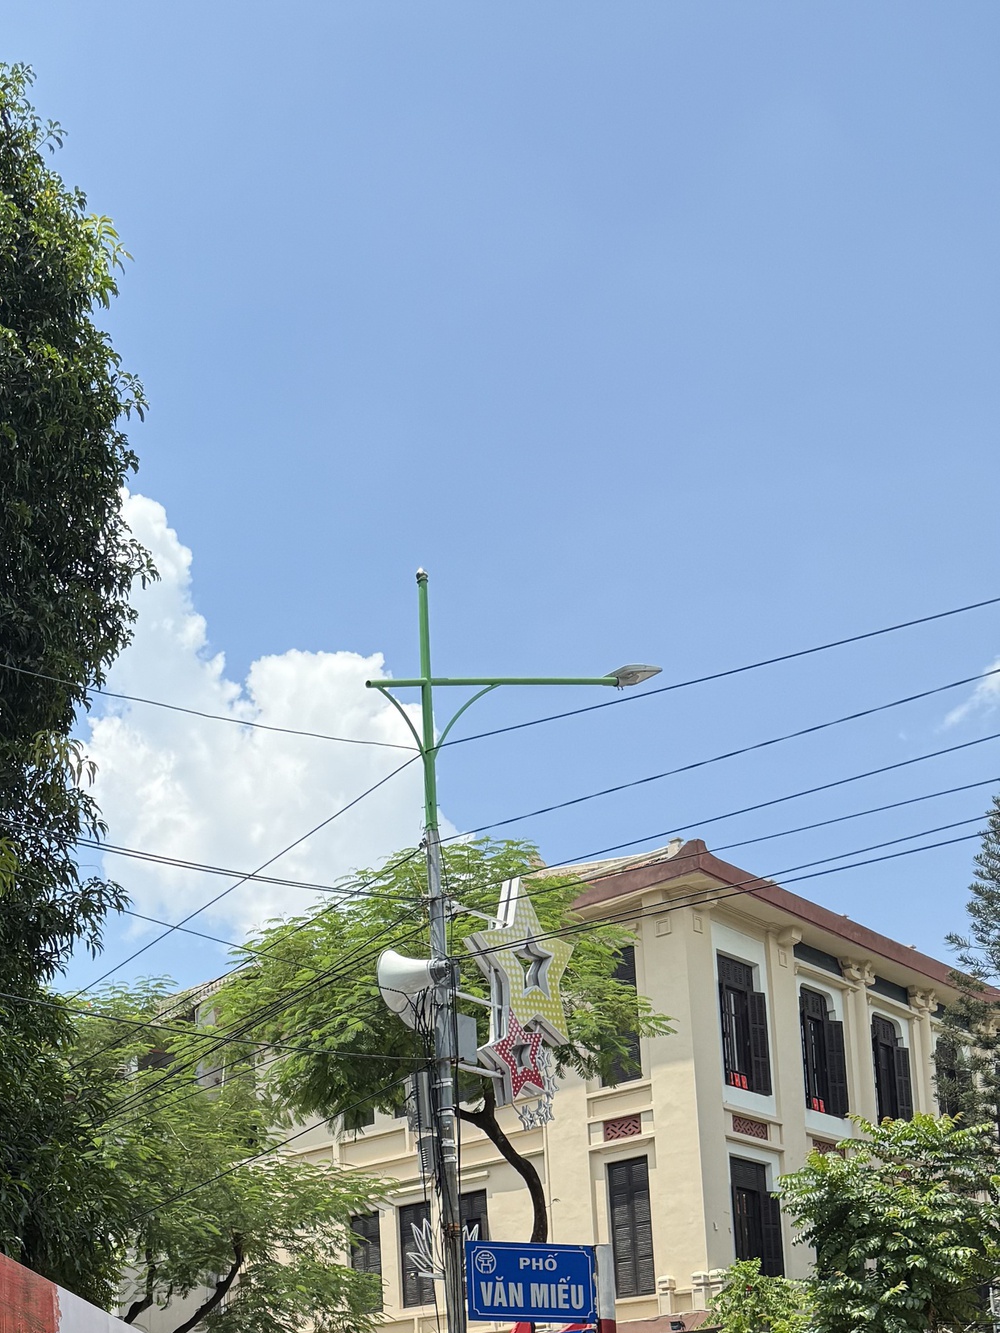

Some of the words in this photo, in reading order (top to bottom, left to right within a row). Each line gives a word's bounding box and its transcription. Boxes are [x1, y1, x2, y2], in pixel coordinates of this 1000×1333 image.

[519, 1252, 558, 1271] PHỐ
[480, 1276, 523, 1308] VĂN
[530, 1275, 584, 1310] MIẾU
